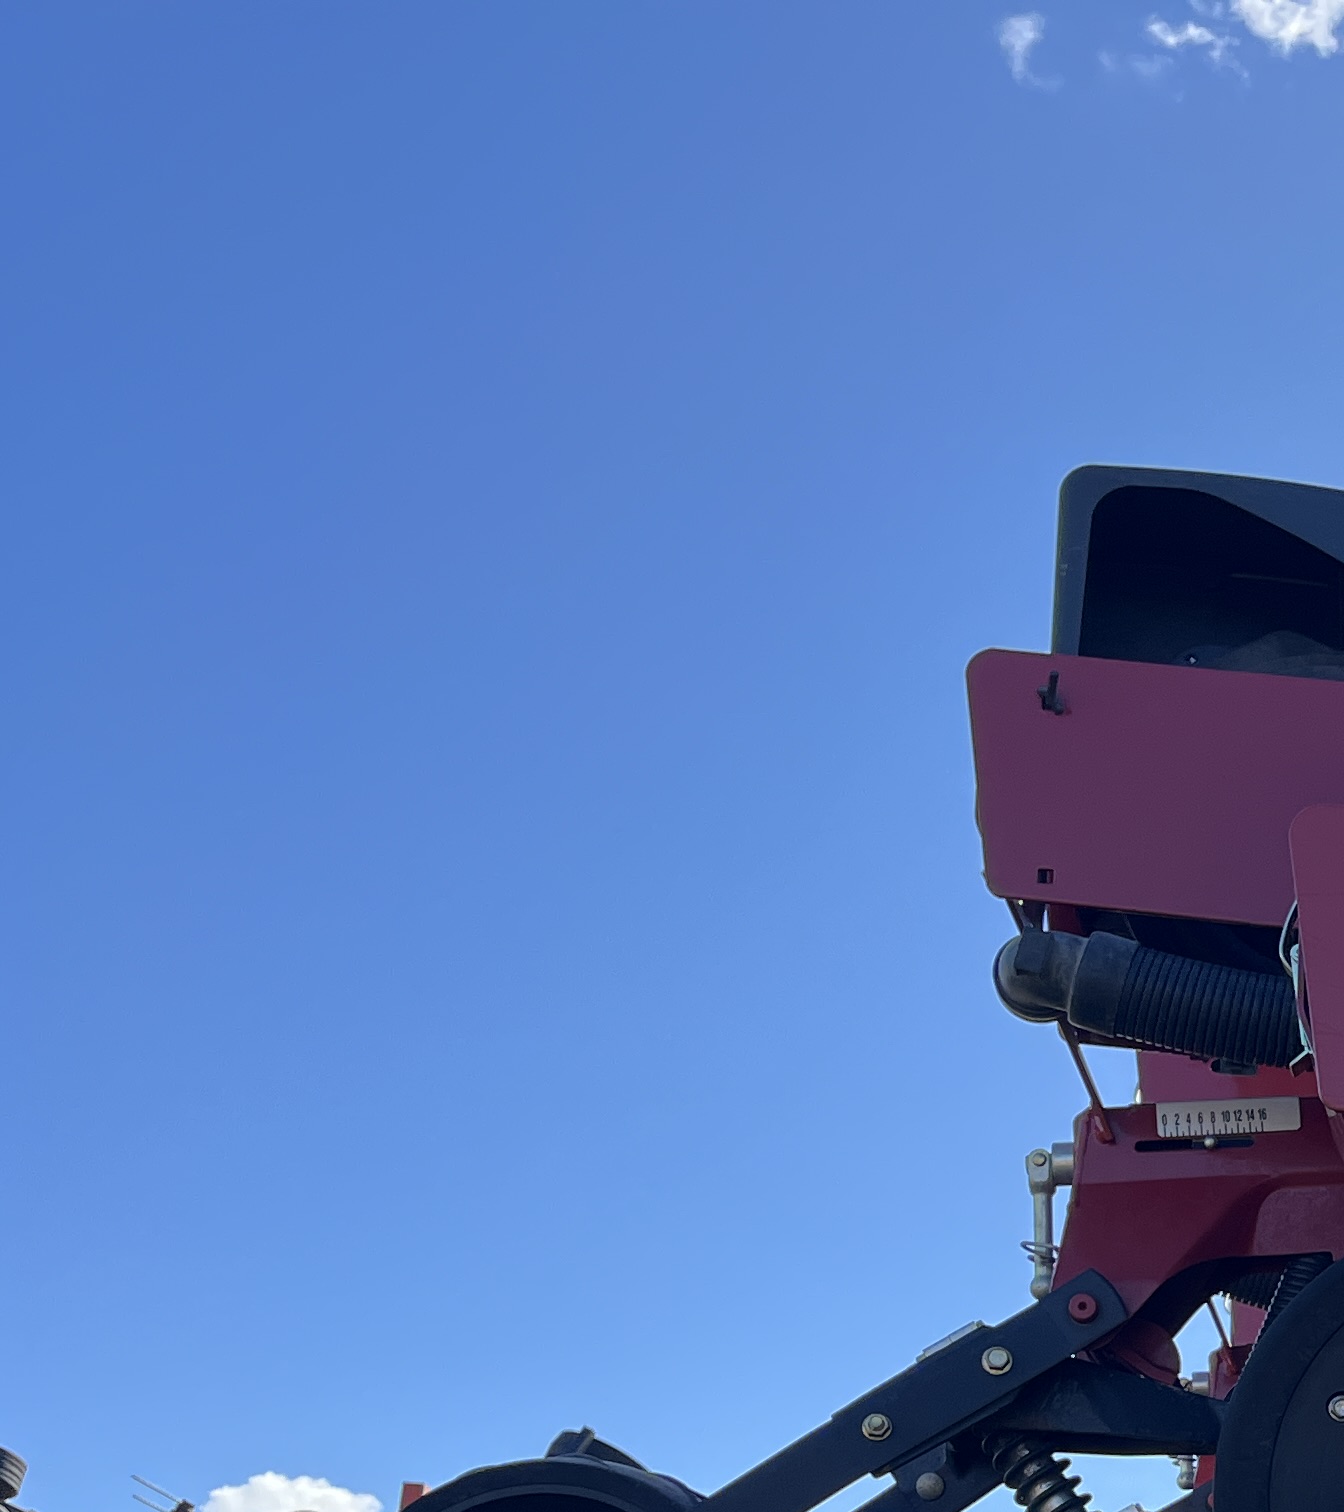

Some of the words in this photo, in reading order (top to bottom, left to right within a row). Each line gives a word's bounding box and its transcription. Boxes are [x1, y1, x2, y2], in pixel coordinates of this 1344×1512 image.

[1162, 1113, 1167, 1126] 0
[1175, 1113, 1180, 1126] 2
[1187, 1112, 1191, 1124] 4
[1198, 1111, 1204, 1124] 6
[1210, 1111, 1216, 1123] 8
[1221, 1110, 1231, 1122] 10
[1233, 1109, 1242, 1122] 12
[1246, 1108, 1255, 1121] 14
[1258, 1107, 1267, 1120] 16
